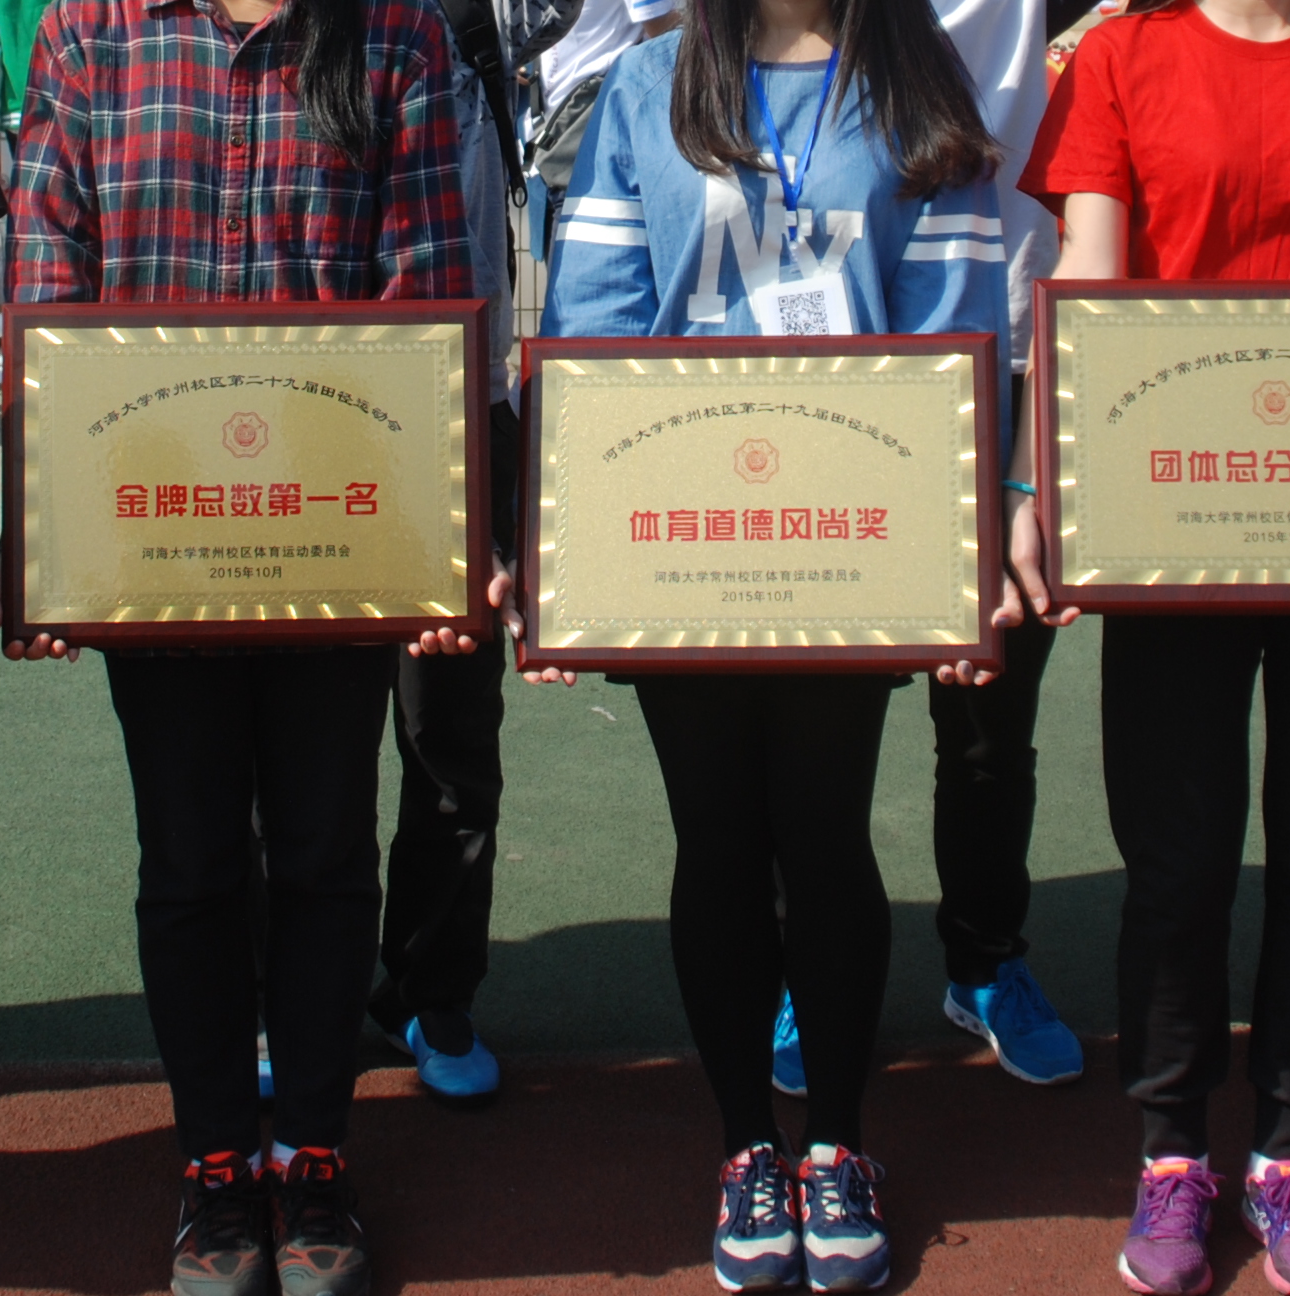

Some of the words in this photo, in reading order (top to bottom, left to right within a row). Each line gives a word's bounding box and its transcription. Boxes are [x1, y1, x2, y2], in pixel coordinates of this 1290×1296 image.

[115, 482, 378, 518] 金牌总数第一名
[629, 508, 889, 542] 体育道德风尚奖
[142, 544, 351, 561] 河海大学常州校区体育运动委员会
[209, 565, 283, 579] 2015年10月
[654, 569, 862, 583] 河海大学常州校区体育运动委员会
[721, 589, 794, 603] 2015年10月
